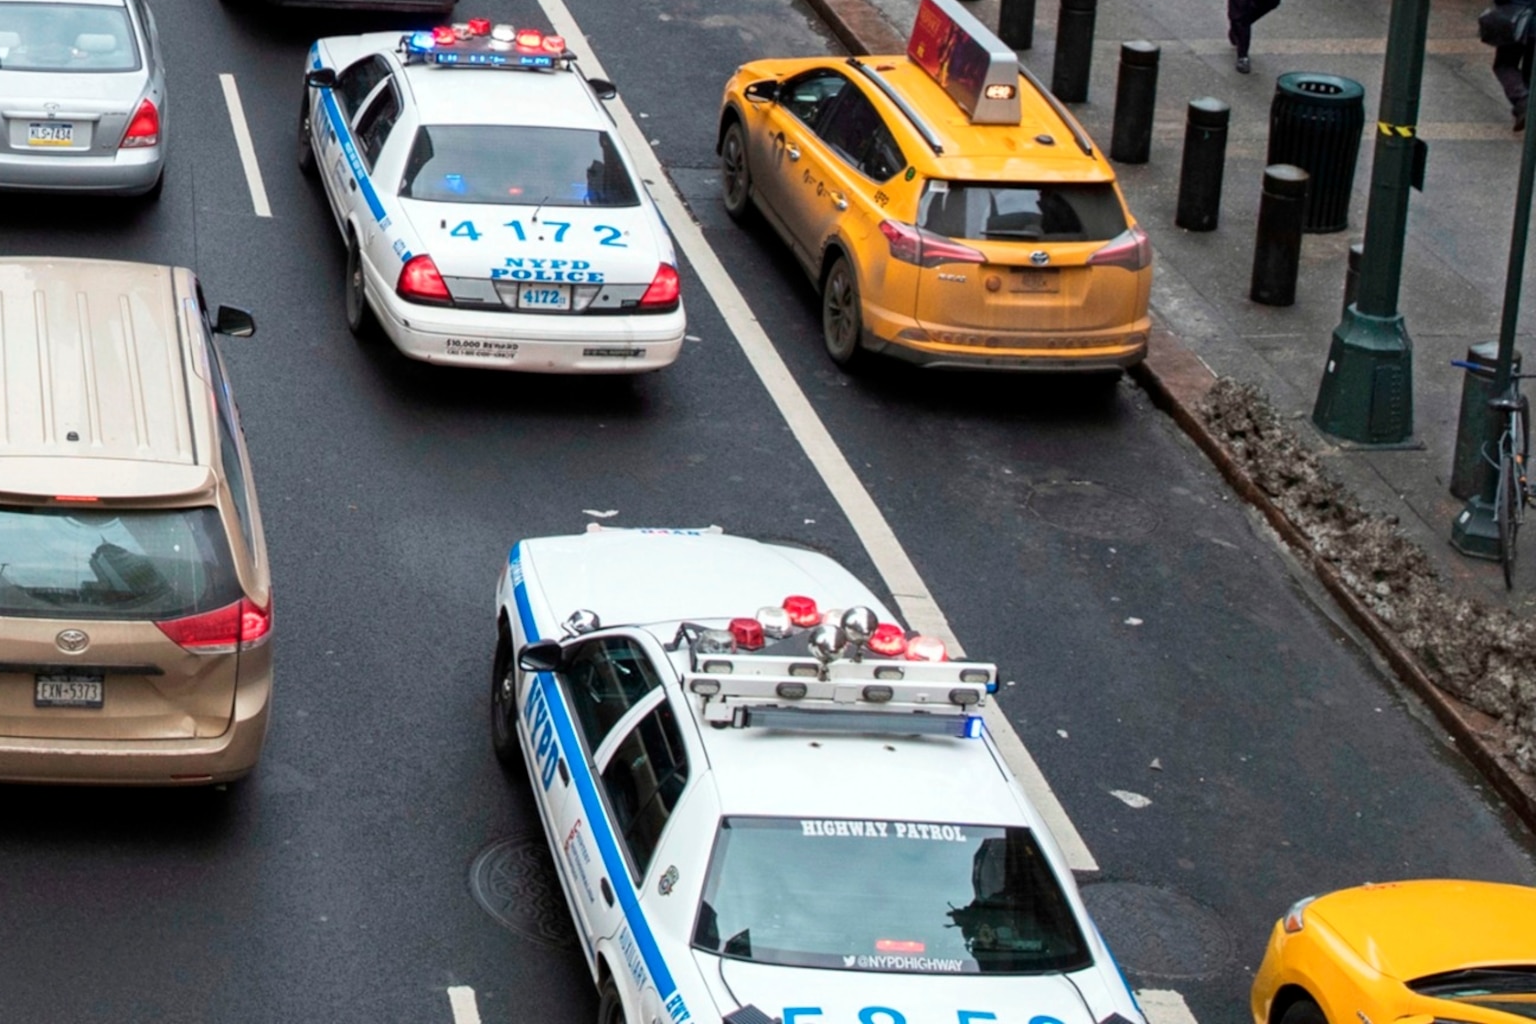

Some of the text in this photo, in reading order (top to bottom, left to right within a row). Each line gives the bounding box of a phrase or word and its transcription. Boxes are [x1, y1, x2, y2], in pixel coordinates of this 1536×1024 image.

[450, 220, 628, 248] 4172
[505, 257, 591, 270] NYPD
[490, 268, 604, 283] POLICE
[523, 290, 560, 304] 4172
[446, 339, 481, 348] $10,000
[524, 673, 559, 793] NYPD
[800, 820, 967, 842] HIGHWAY PATROL
[619, 926, 648, 991] AUXILIARY
[858, 955, 963, 973] @NYPDHIGHWAY
[666, 994, 692, 1024] HWY
